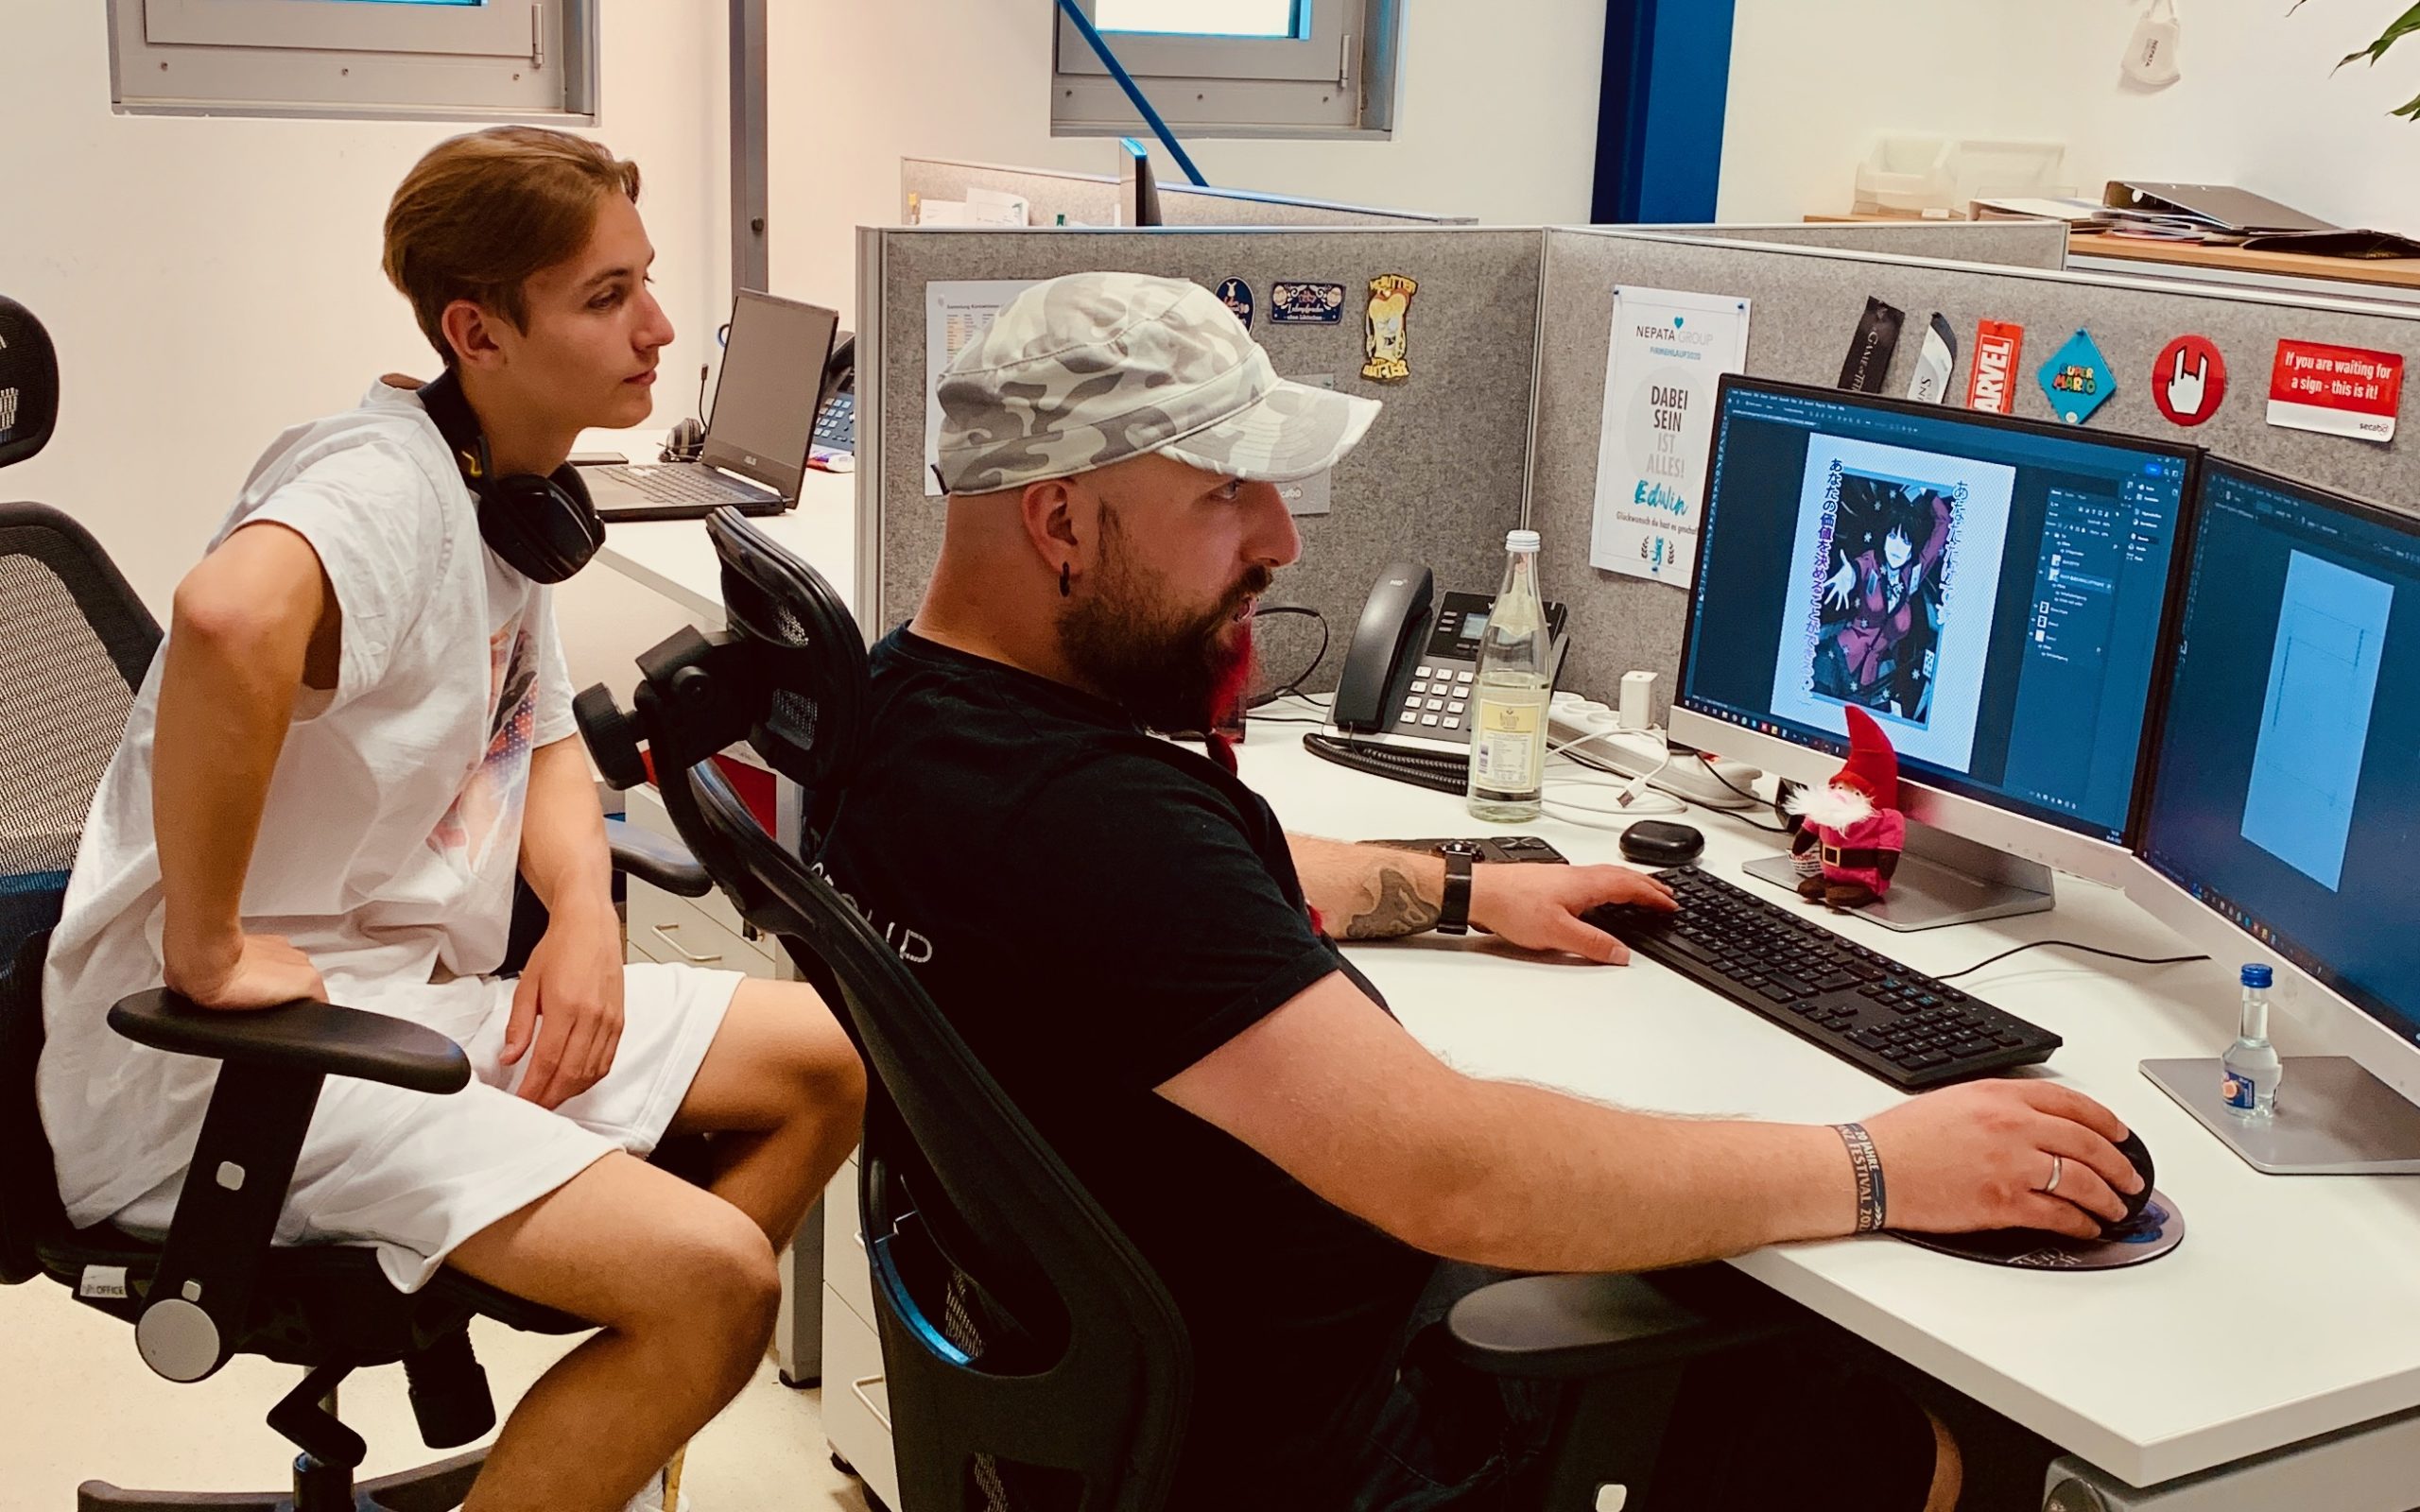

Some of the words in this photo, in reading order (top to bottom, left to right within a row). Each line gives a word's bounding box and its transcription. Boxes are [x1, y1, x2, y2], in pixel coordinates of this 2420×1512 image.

[1635, 325, 1675, 341] NEPATA
[1678, 331, 1714, 346] GROUP
[1974, 341, 2010, 414] ARVEL
[2060, 363, 2094, 379] SUPER
[2285, 352, 2295, 366] If
[2294, 355, 2314, 370] you
[2315, 358, 2332, 371] are
[2335, 359, 2374, 381] waiting
[2377, 364, 2393, 379] for
[2052, 373, 2097, 395] MARIO
[2291, 377, 2299, 388] a
[2300, 376, 2323, 394] sign
[2331, 380, 2352, 396] this
[2353, 383, 2363, 398] is
[2365, 384, 2378, 400] it!
[1651, 386, 1688, 410] DABEI
[1653, 409, 1682, 432] SEIN
[1657, 432, 1676, 454] IST
[1646, 454, 1685, 479] ALLES!
[1634, 479, 1688, 516] Edwin
[1859, 1141, 1879, 1172] JAHRE
[1849, 1143, 1872, 1203] FESTIVAL
[96, 1285, 124, 1295] OFFICE
